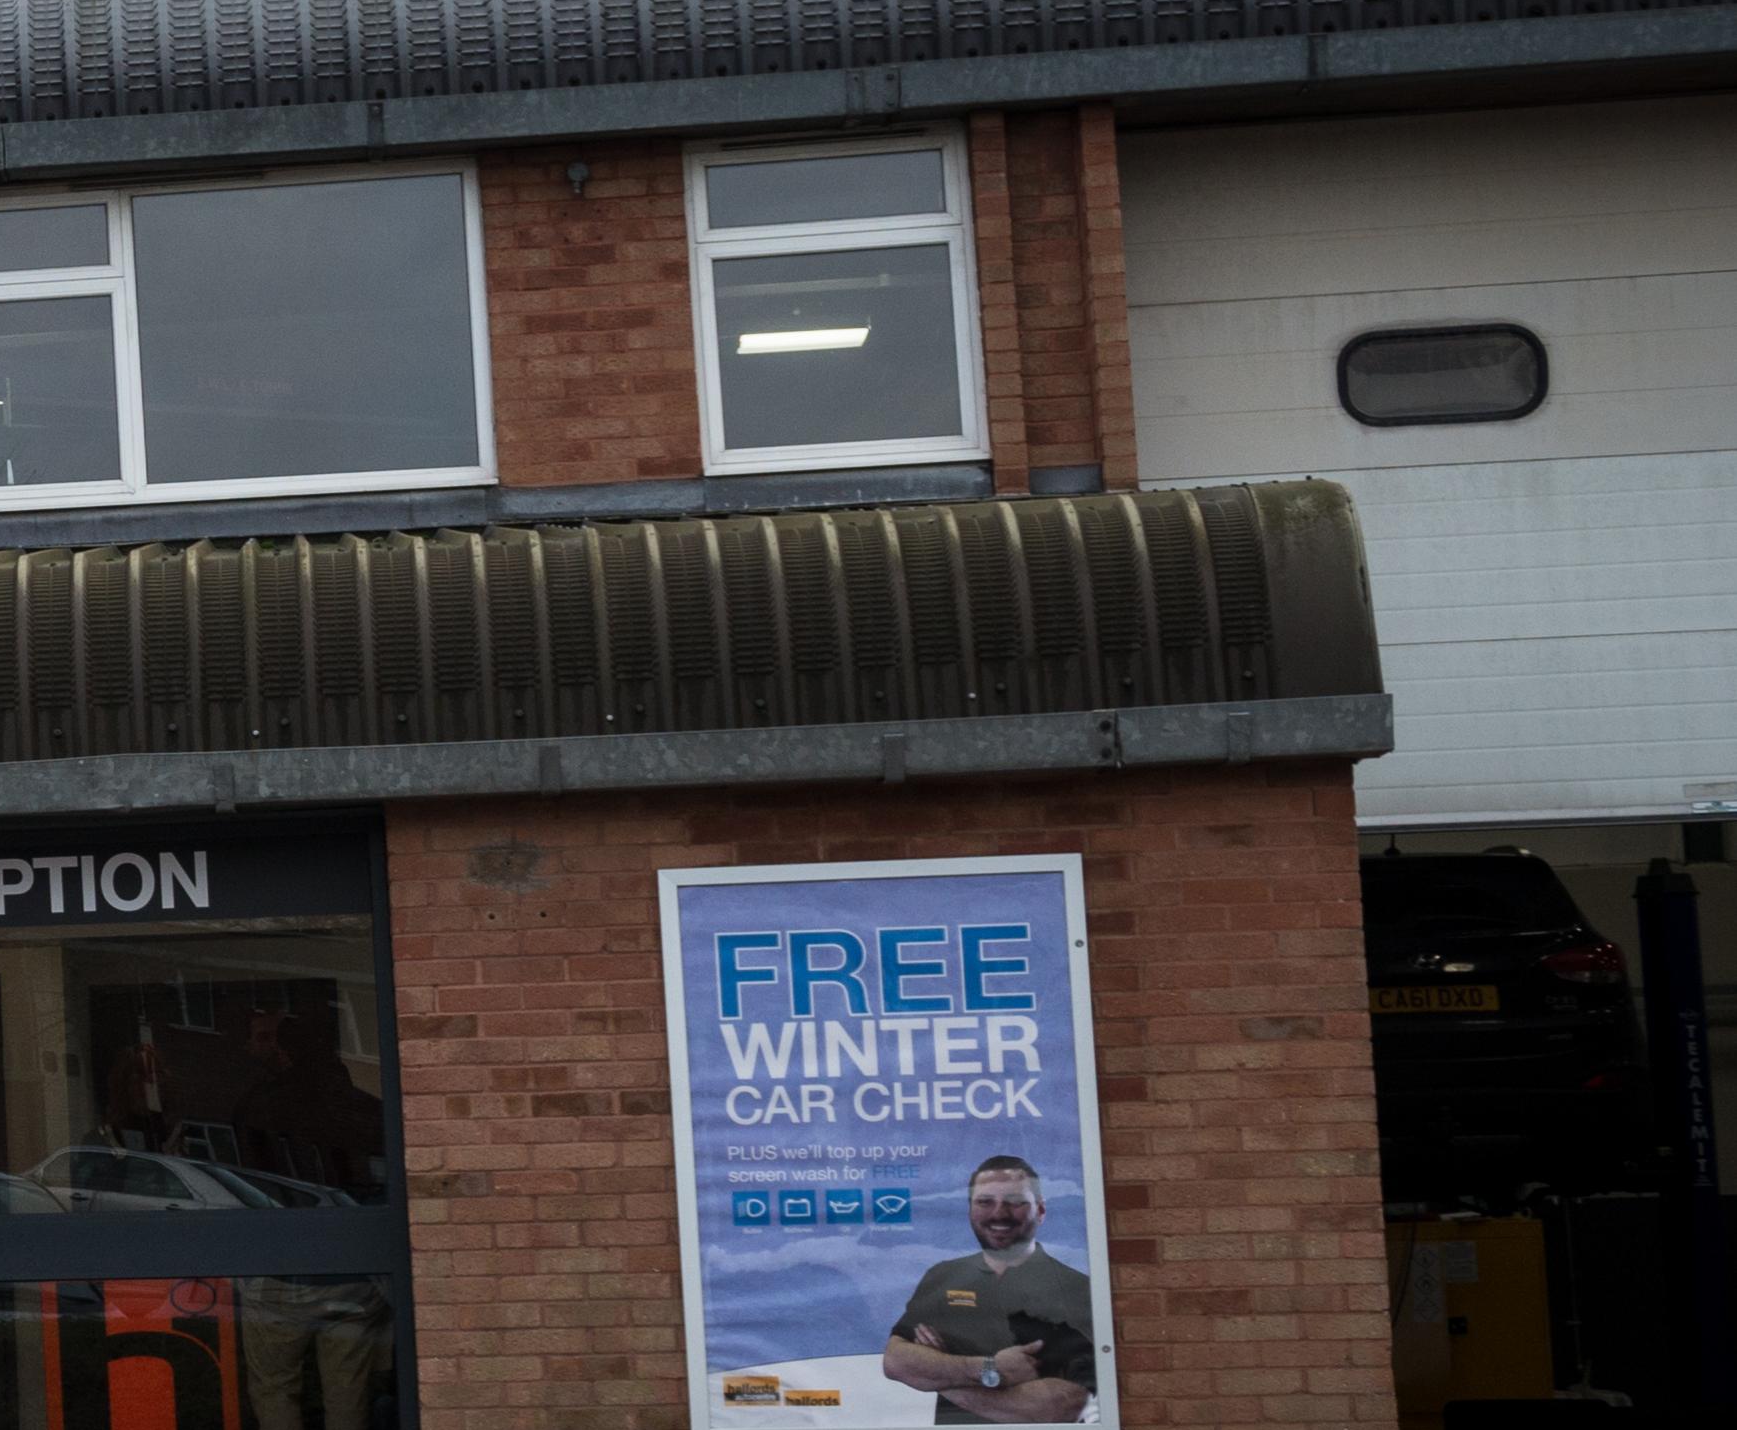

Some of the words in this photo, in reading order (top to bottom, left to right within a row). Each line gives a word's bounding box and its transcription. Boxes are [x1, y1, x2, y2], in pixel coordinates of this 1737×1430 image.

[714, 922, 1037, 1021] FREE
[720, 1015, 1043, 1080] WINTER
[725, 1084, 837, 1125] CAR
[853, 1078, 1043, 1122] CHECK
[1686, 1024, 1710, 1174] TECALEMIT
[727, 1145, 778, 1161] PLUS
[782, 1145, 822, 1159] we'll
[826, 1144, 856, 1161] top
[862, 1146, 885, 1160] up
[889, 1144, 928, 1161] your
[728, 1169, 786, 1183] screen
[792, 1167, 838, 1181] wash
[843, 1165, 867, 1181] for
[872, 1164, 920, 1179] FREE
